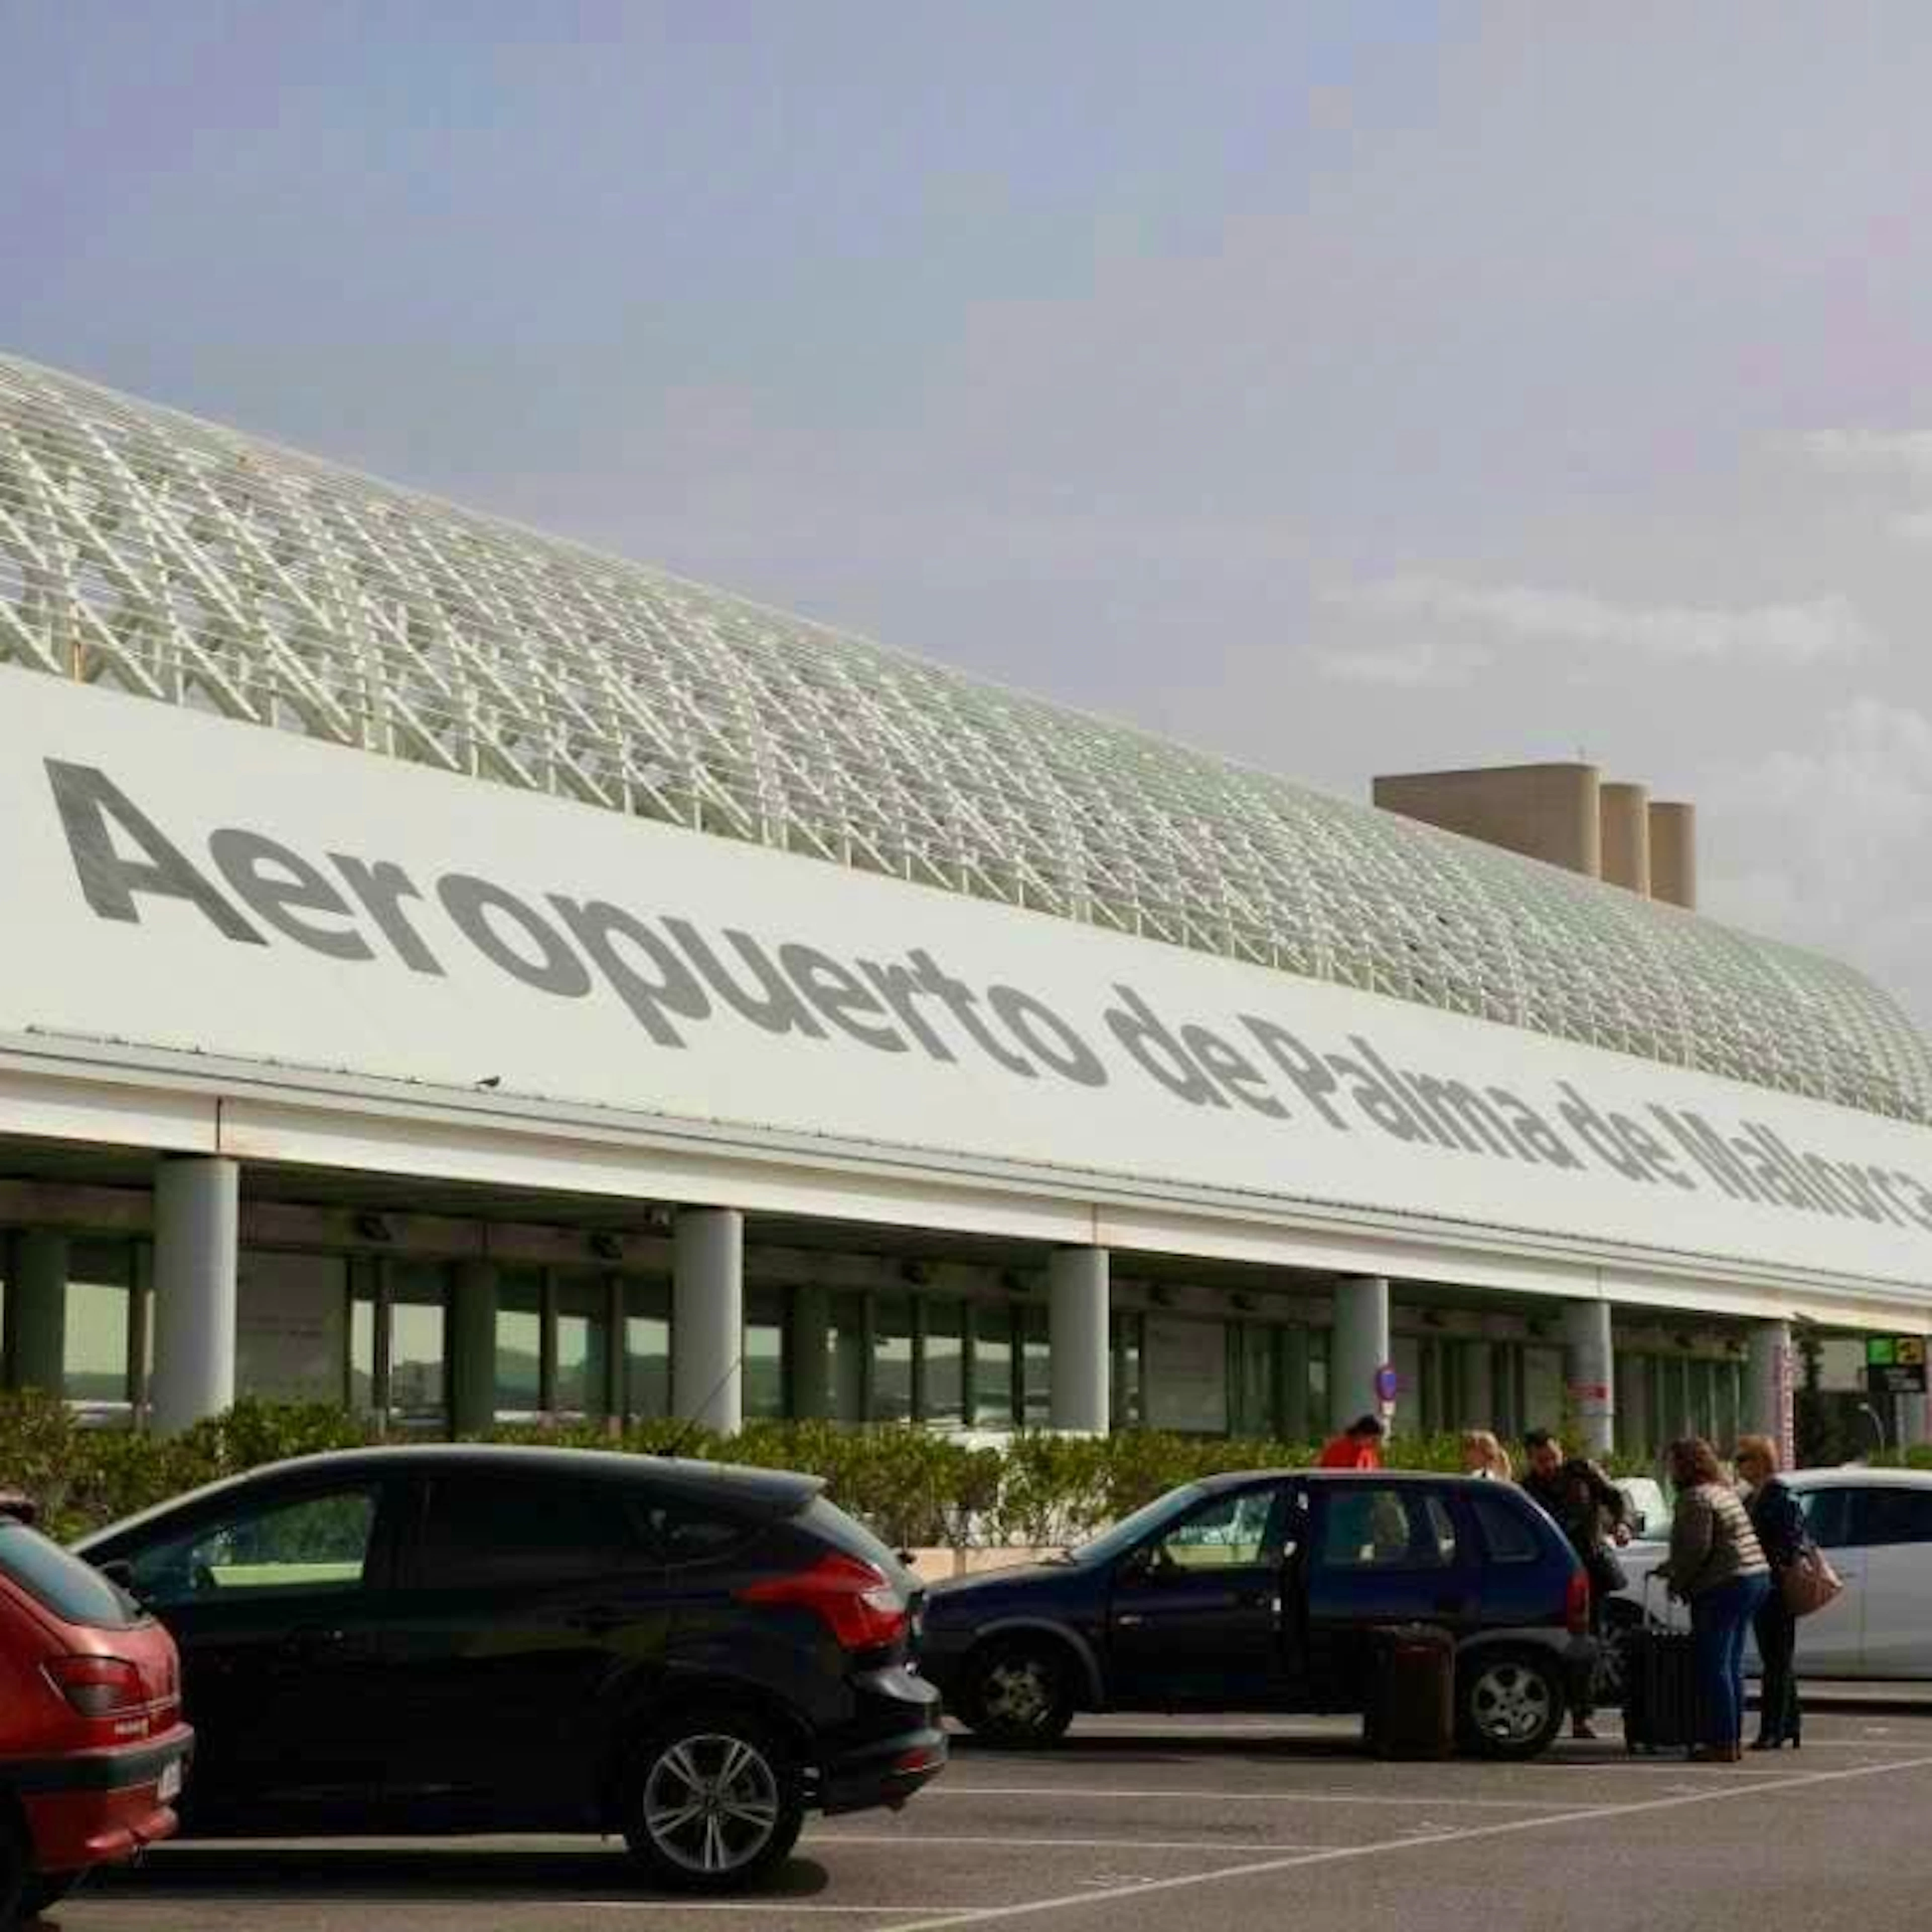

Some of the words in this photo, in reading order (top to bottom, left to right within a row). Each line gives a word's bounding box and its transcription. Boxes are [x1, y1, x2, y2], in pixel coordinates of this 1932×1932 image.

[42, 756, 1108, 1088] Aeropuerto
[1103, 983, 1292, 1119] de
[1237, 1014, 1588, 1170] Palma
[1556, 1081, 1697, 1190] de
